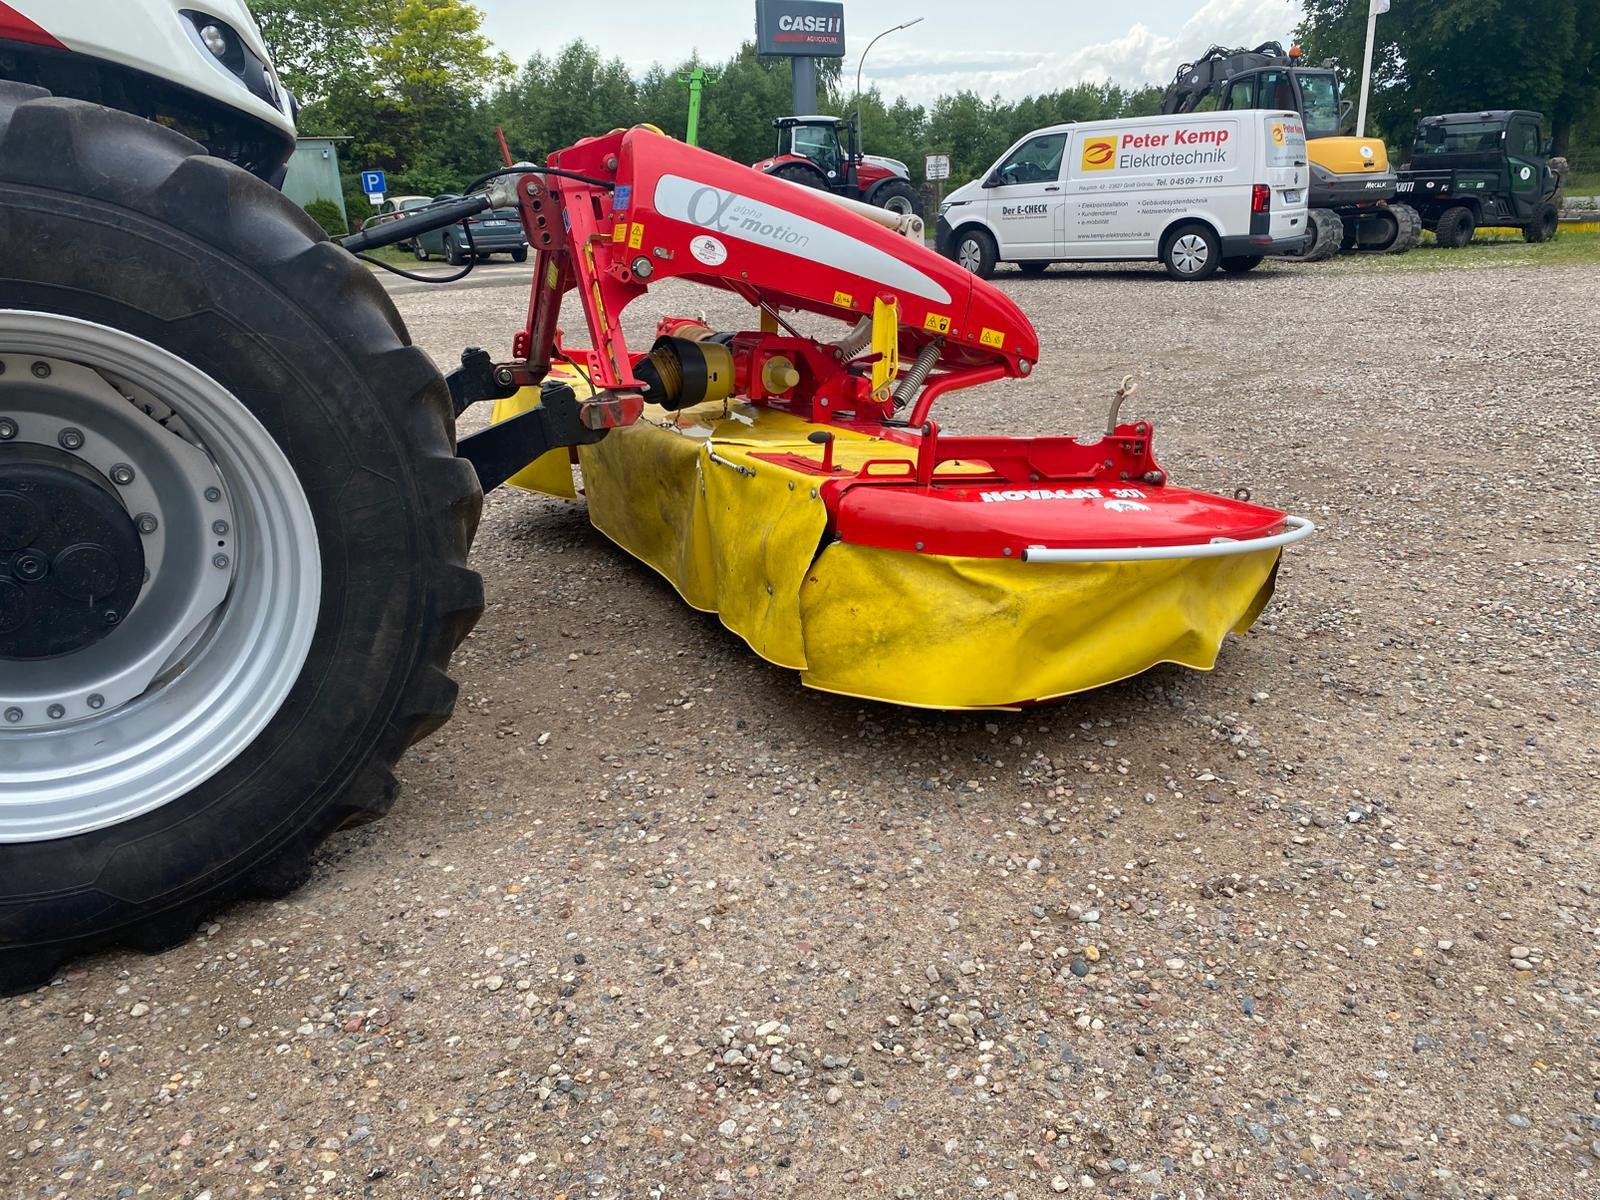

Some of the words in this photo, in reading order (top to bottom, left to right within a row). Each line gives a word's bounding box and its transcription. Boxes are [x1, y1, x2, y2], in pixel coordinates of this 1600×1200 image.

[779, 15, 826, 32] CASE
[1121, 133, 1169, 149] Peter
[1174, 129, 1229, 146] Kemp
[1120, 149, 1226, 169] Elektrotechnik
[367, 174, 379, 191] P
[1156, 178, 1168, 186] Tel.
[734, 205, 763, 218] alpha
[1017, 204, 1048, 214] E-CHECK
[979, 488, 1104, 503] NOVACAT
